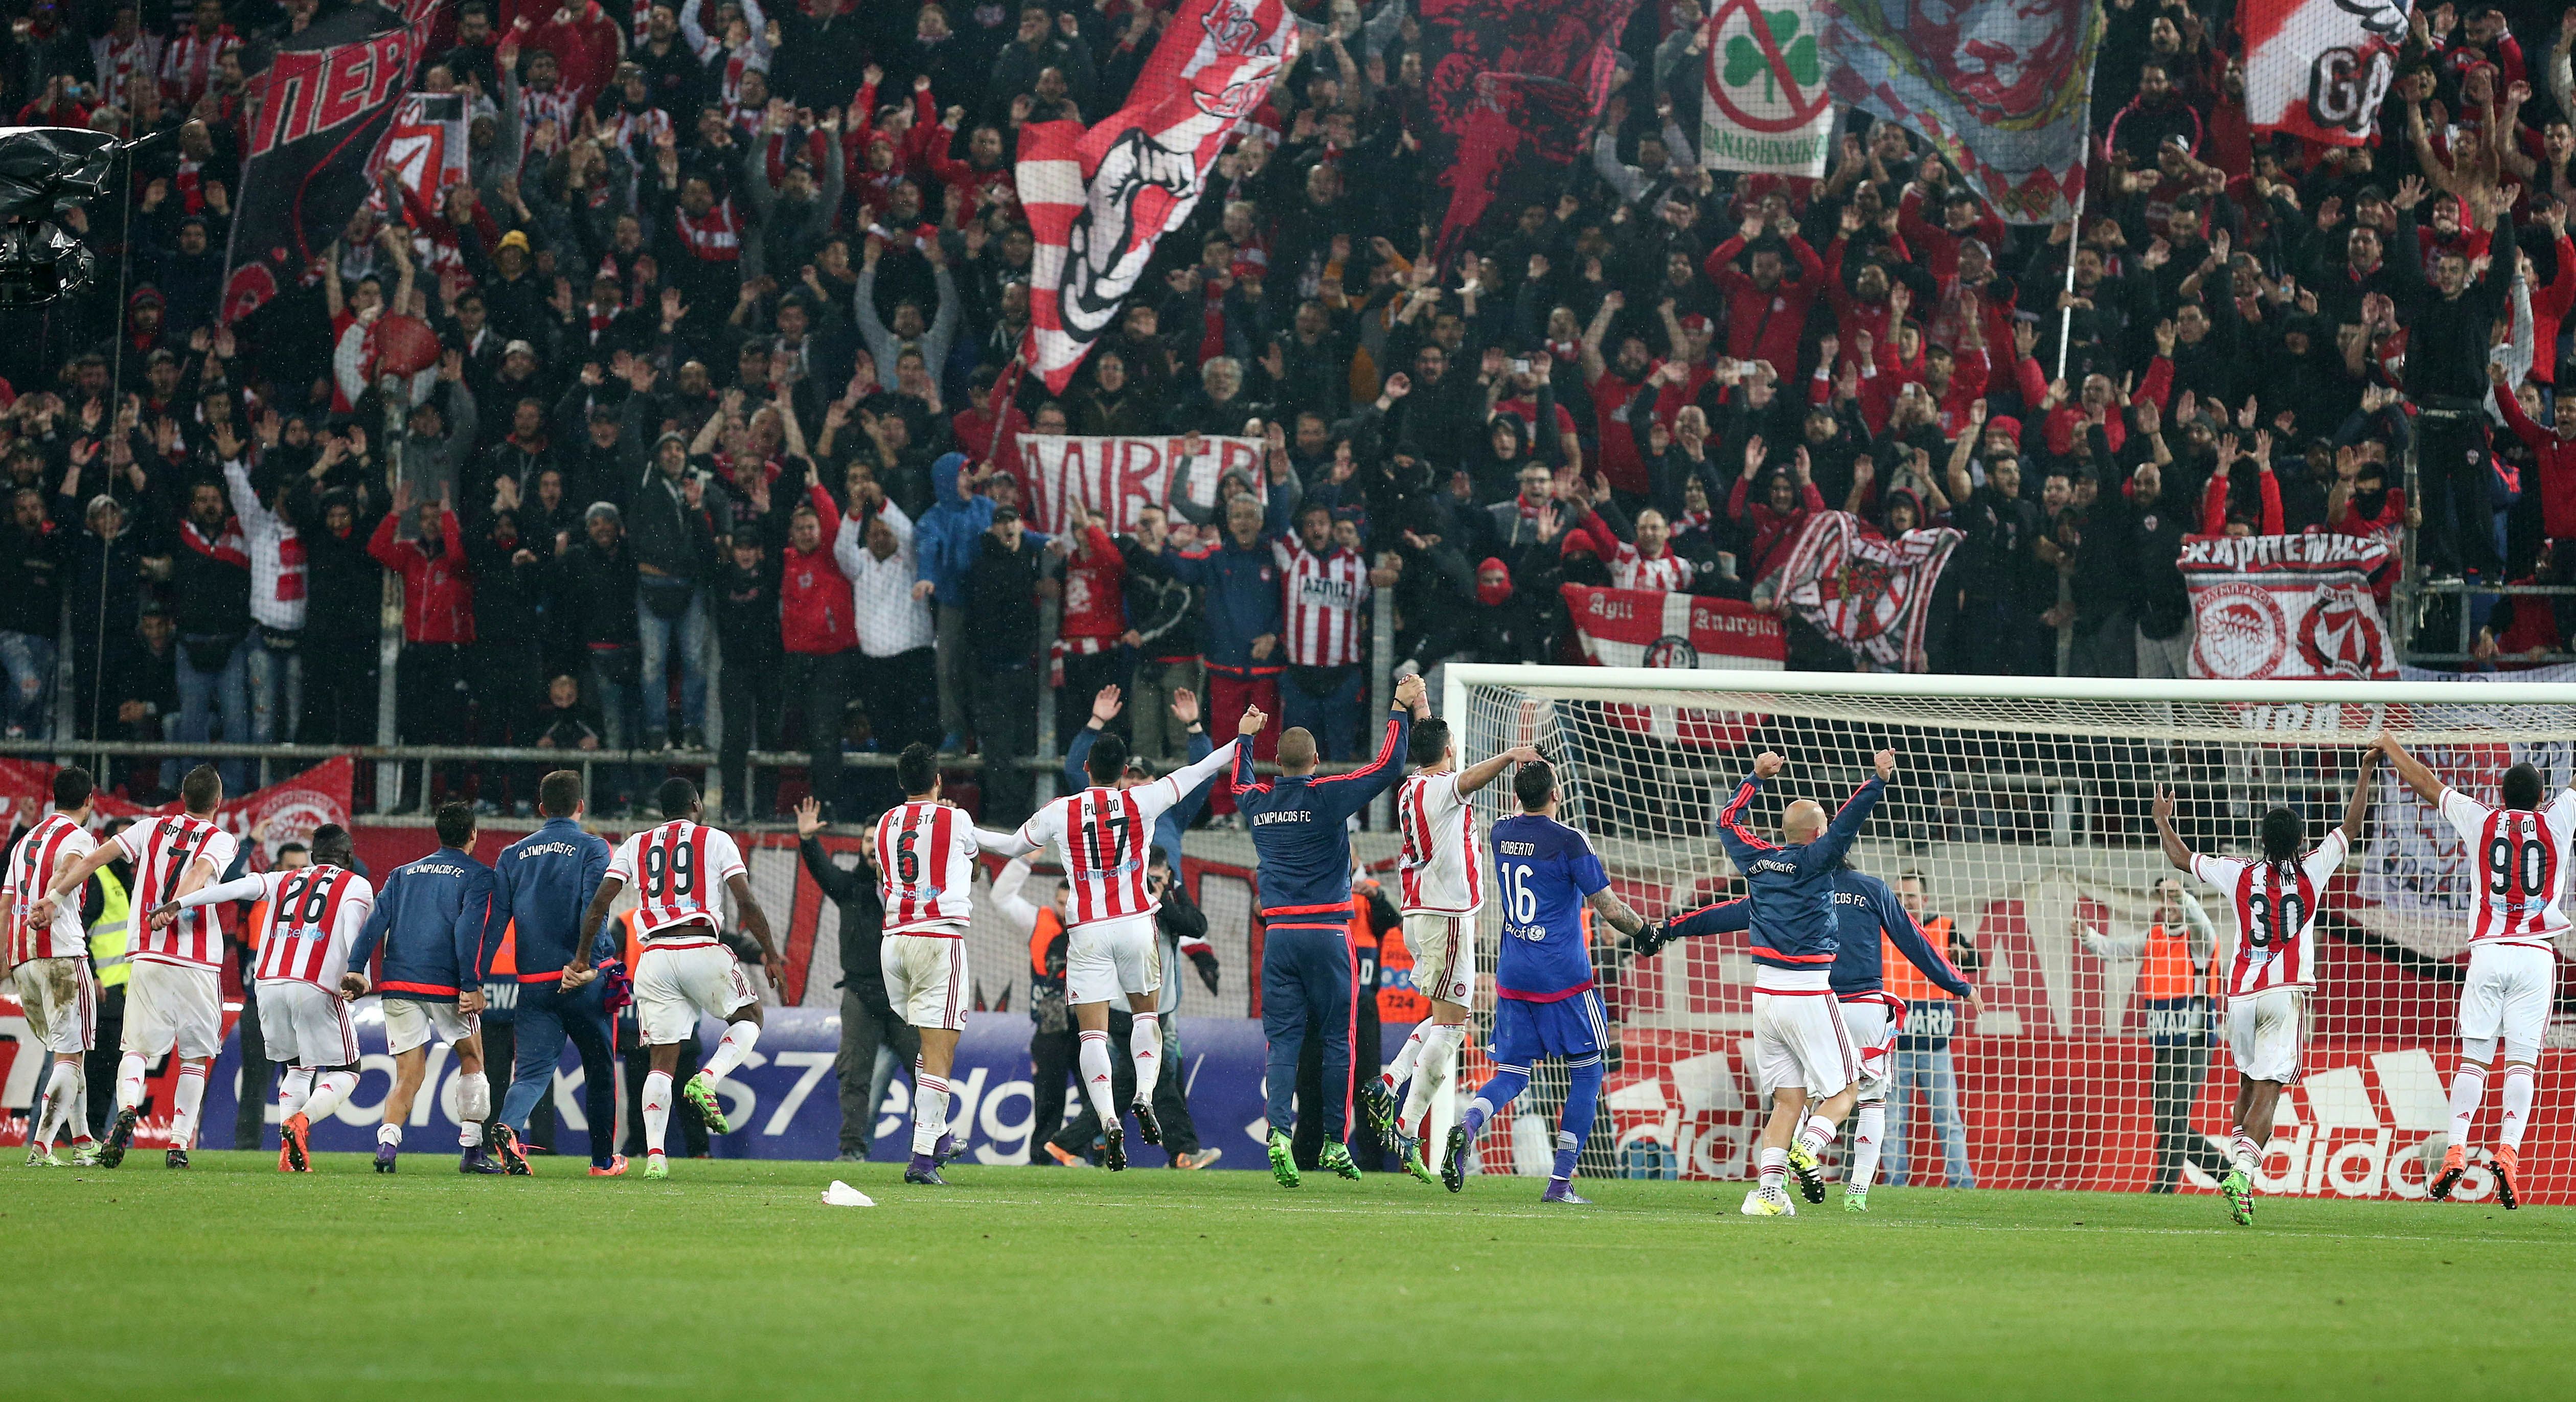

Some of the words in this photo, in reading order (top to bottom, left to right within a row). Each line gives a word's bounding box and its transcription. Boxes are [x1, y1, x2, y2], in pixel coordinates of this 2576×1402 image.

[1084, 799, 1120, 816] PULIDO
[1253, 810, 1298, 826] OLYMPIACOS
[1300, 810, 1311, 822] FC
[519, 841, 565, 860] OLYMPIACOS
[563, 844, 576, 857] FC
[1081, 816, 1130, 870] 17
[1500, 840, 1535, 857] ROBERTO
[897, 830, 919, 884] 6
[20, 840, 43, 897] 5
[162, 846, 191, 904] 7
[406, 864, 453, 875] OLYMPIACOS
[451, 867, 465, 878] FC
[645, 841, 694, 899] 99
[1077, 865, 1124, 881] unicef
[1786, 863, 1797, 874] FC
[2489, 837, 2547, 897] 90
[277, 876, 334, 924] 26
[1501, 862, 1537, 924] 16
[1854, 895, 1866, 907] FC
[2248, 893, 2305, 948] 30
[270, 925, 308, 938] unicef
[1387, 995, 1415, 1008] 724
